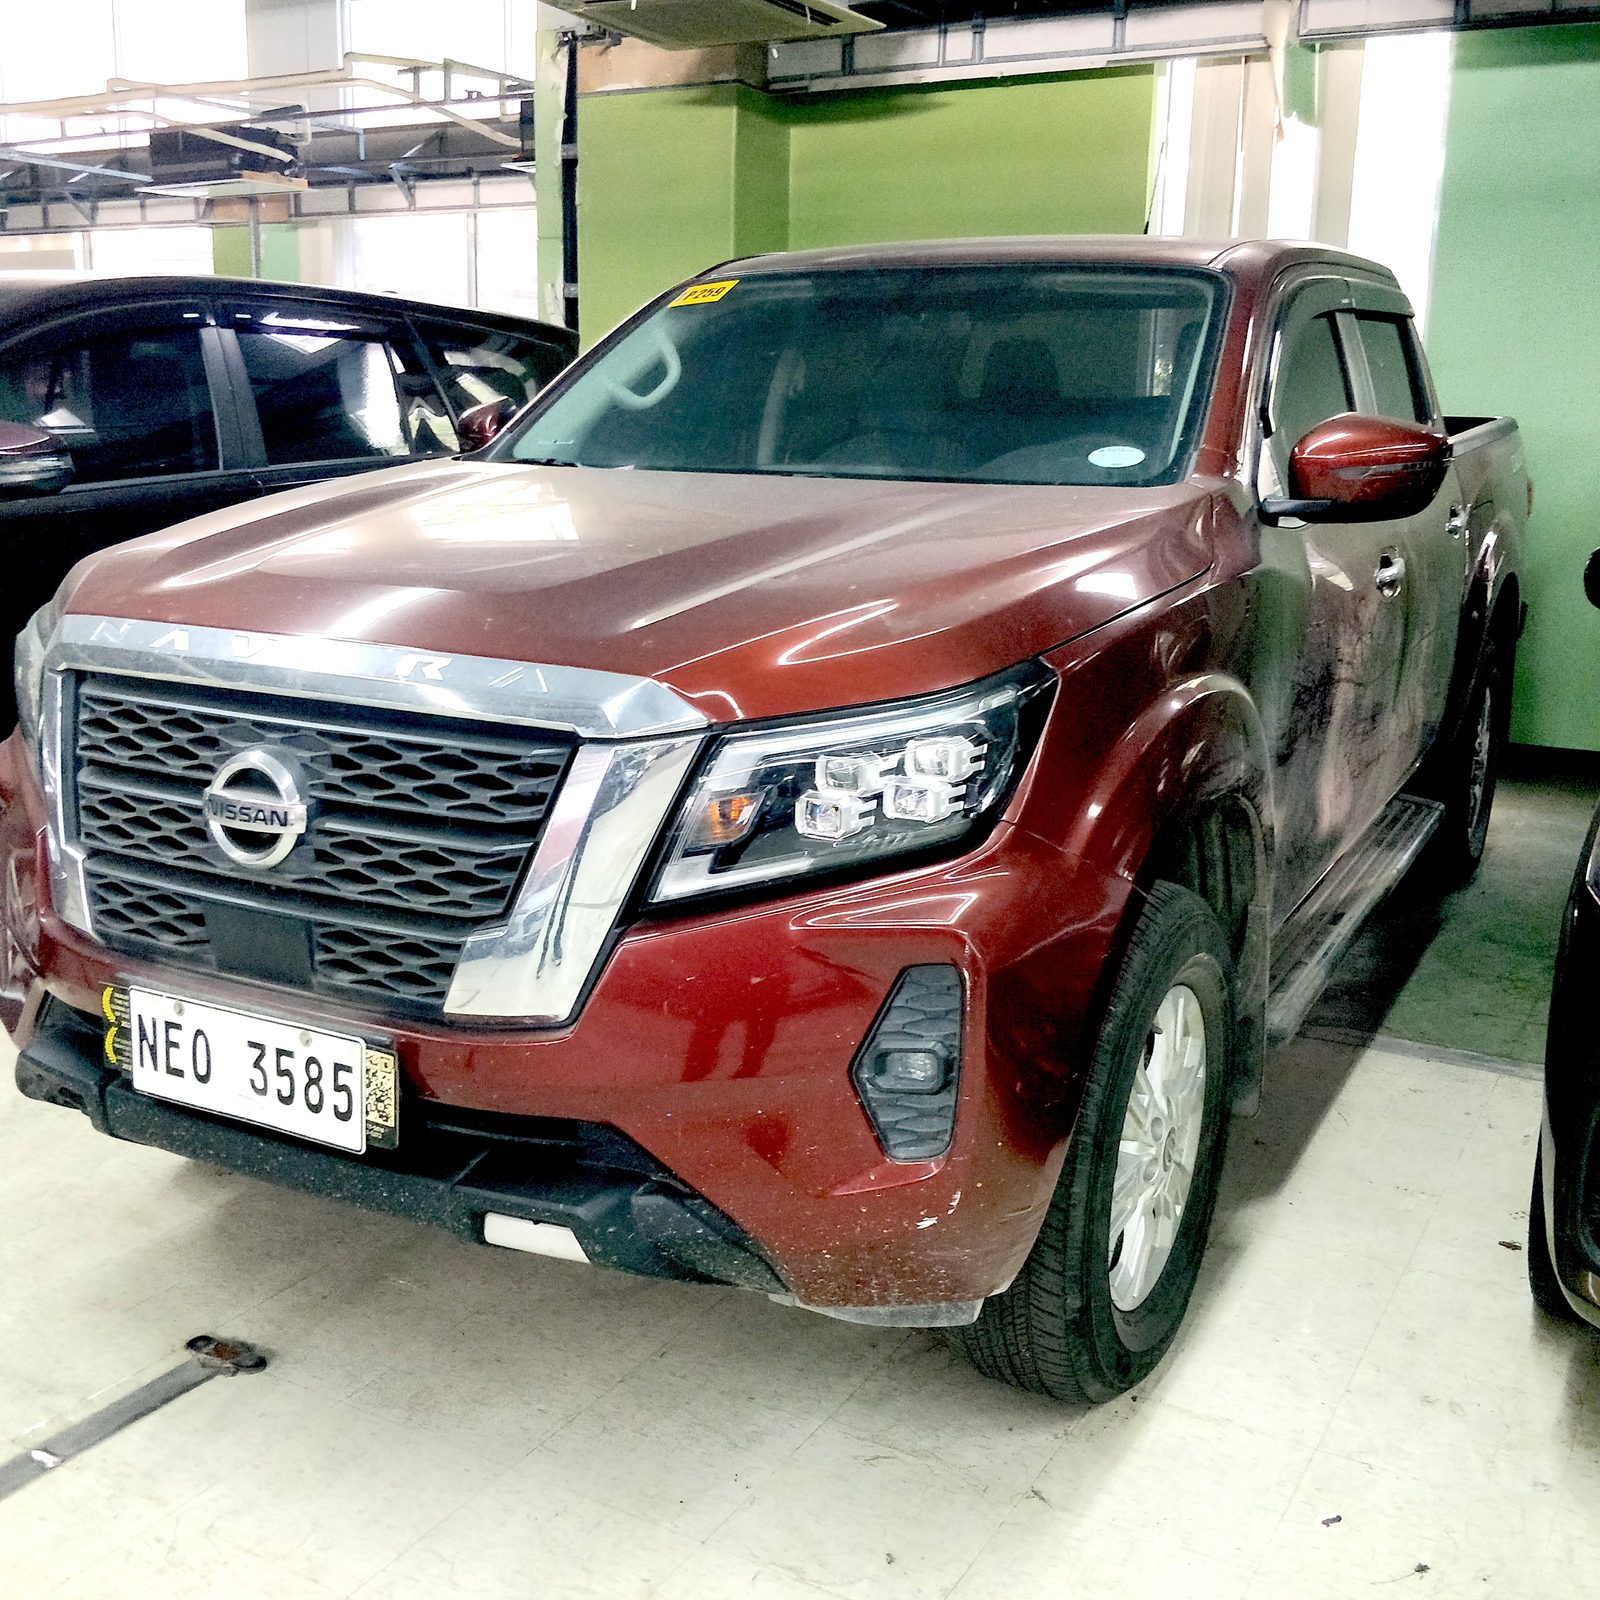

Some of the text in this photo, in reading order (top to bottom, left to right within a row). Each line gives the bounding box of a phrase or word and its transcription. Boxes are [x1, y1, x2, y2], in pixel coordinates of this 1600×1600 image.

[683, 286, 727, 301] P259
[89, 619, 549, 694] NAVRA
[207, 797, 289, 828] NISSAN
[137, 1014, 212, 1084] NEO
[247, 1040, 354, 1122] 3585
